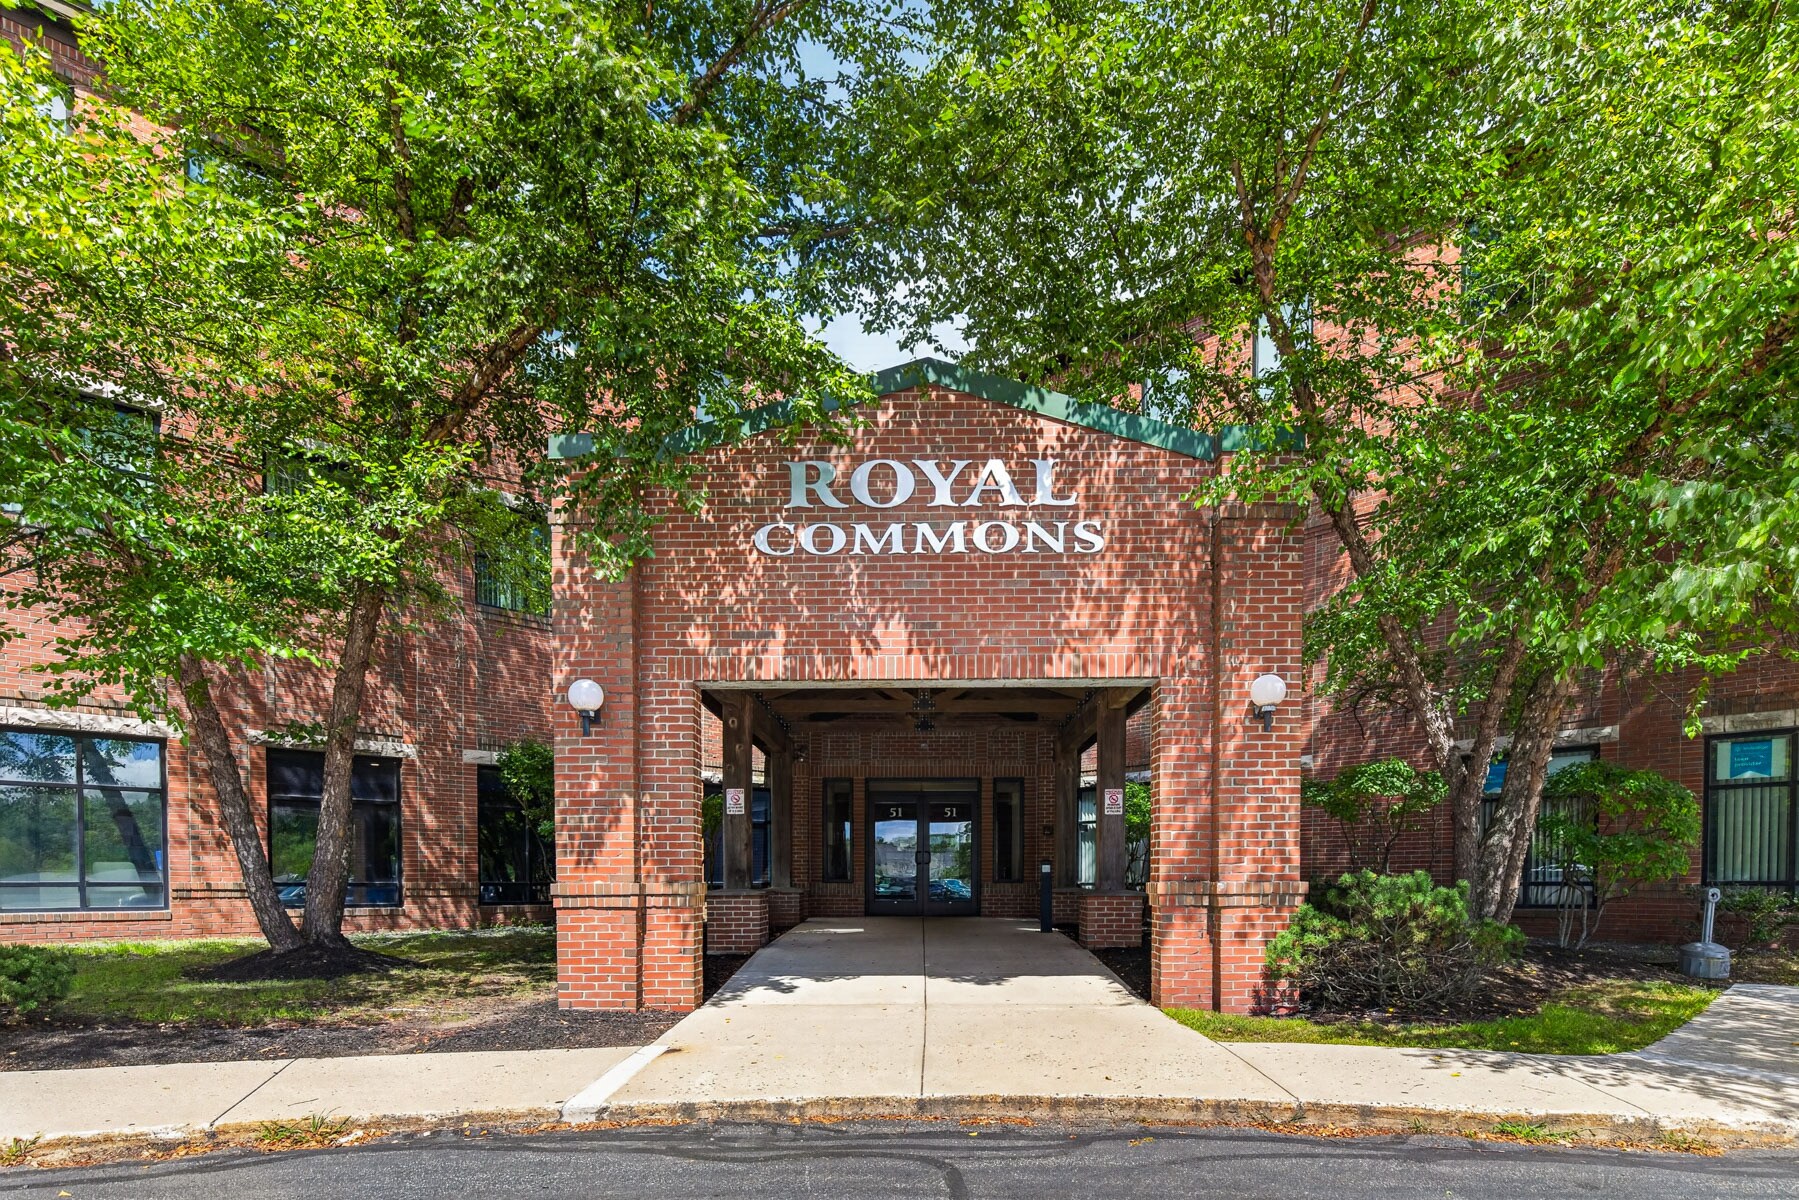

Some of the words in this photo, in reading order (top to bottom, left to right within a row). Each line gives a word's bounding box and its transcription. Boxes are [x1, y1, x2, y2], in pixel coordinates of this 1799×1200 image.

[783, 459, 1078, 508] ROYAL
[754, 521, 1105, 555] COMMONS
[889, 807, 902, 818] 51
[944, 807, 957, 818] 51
